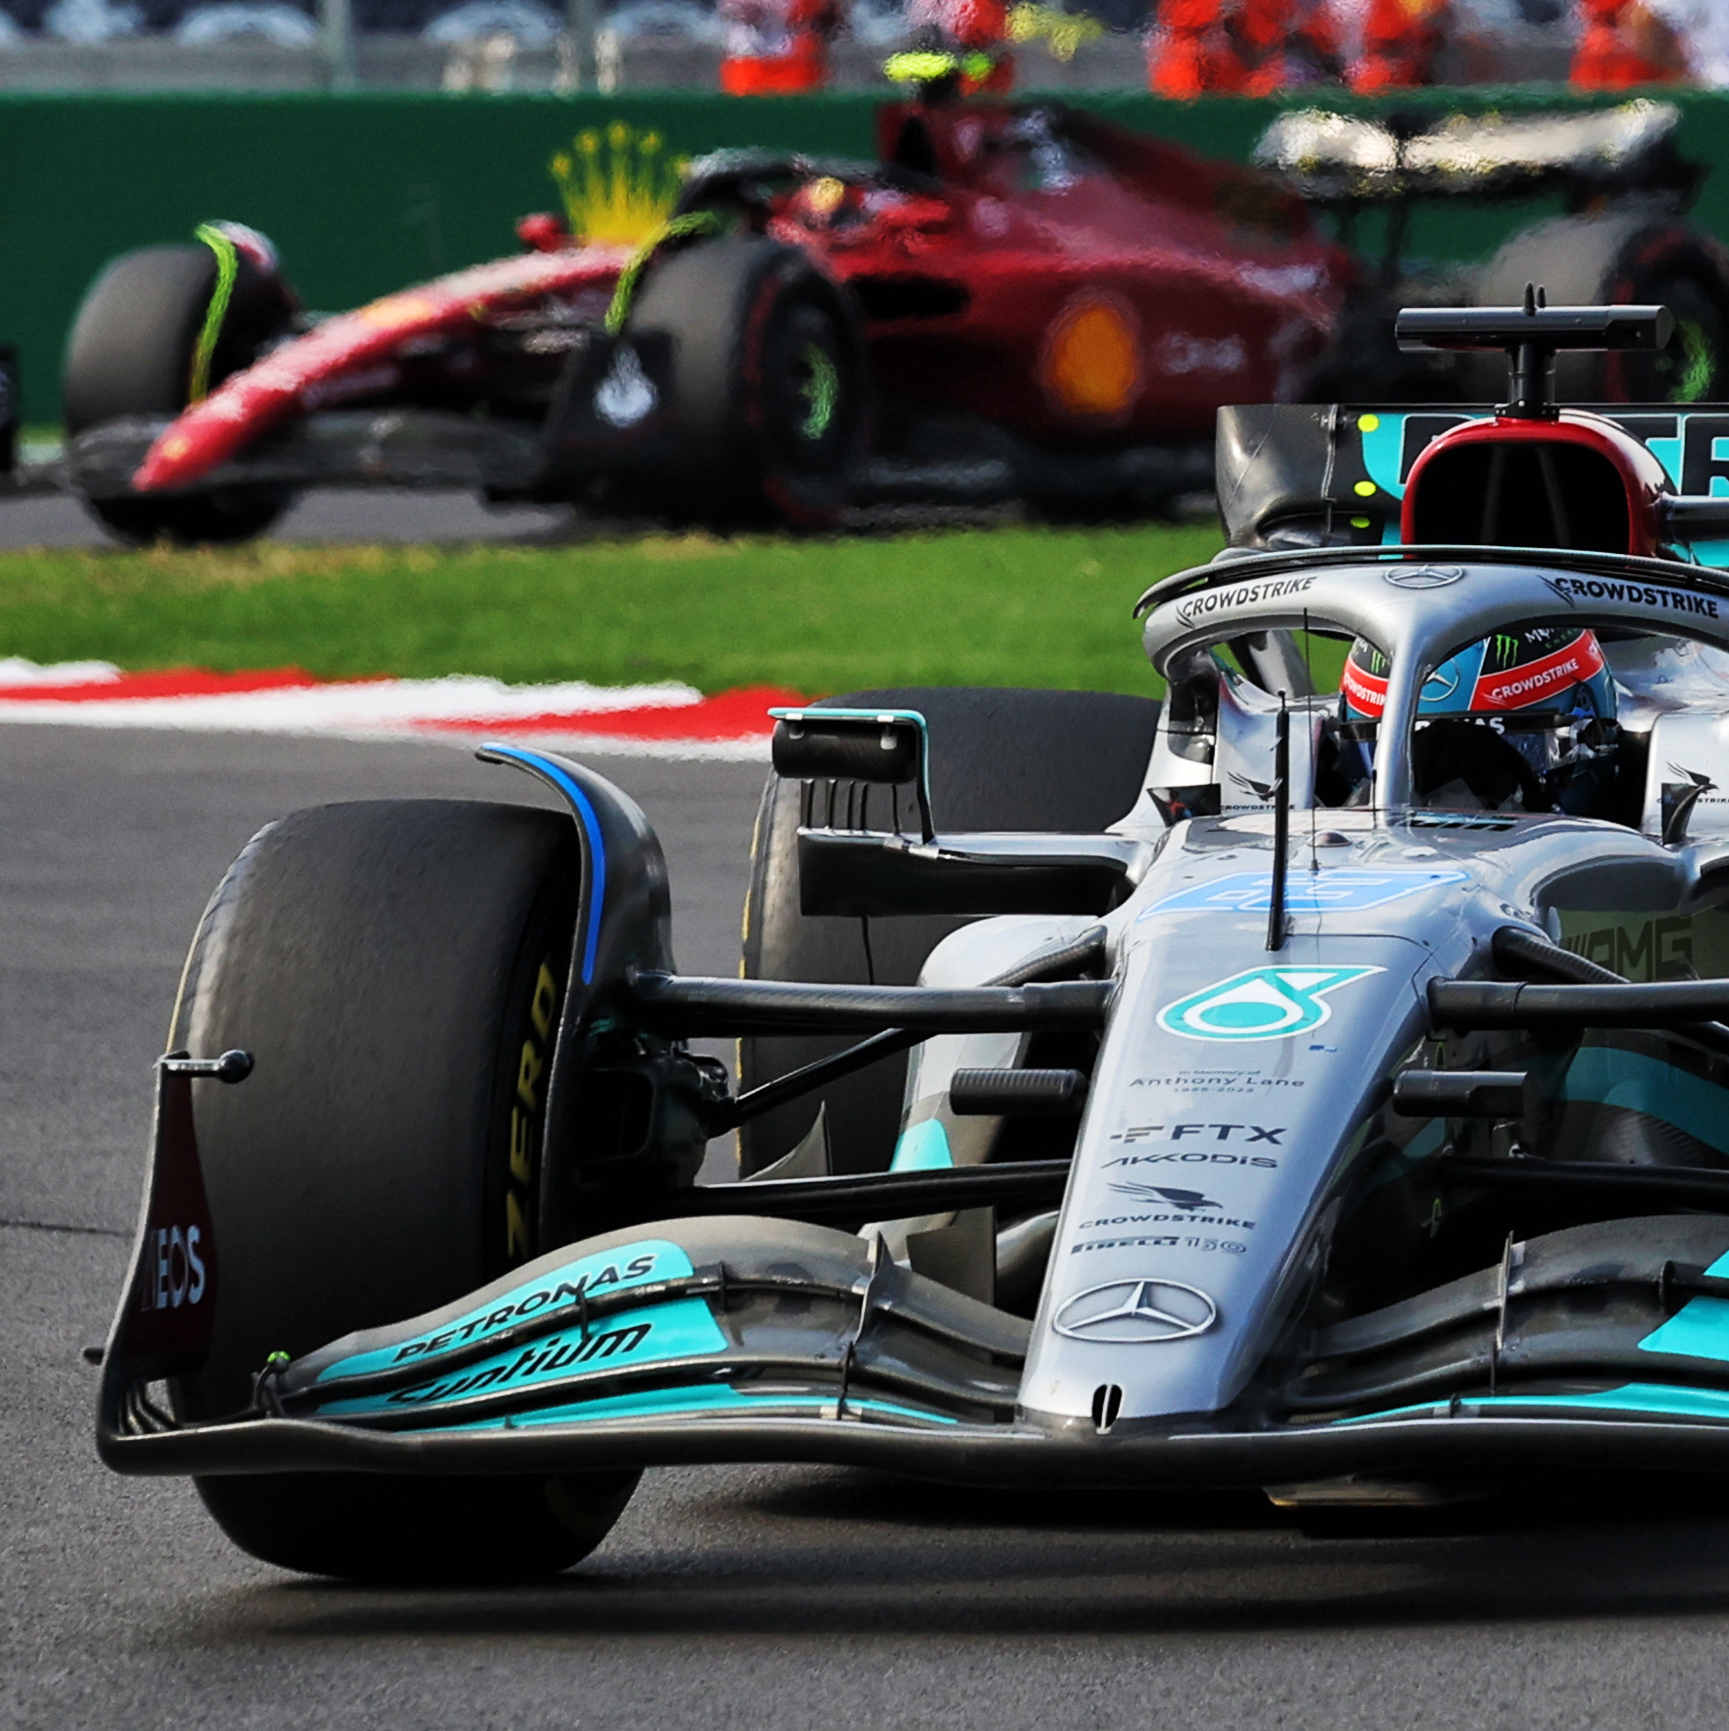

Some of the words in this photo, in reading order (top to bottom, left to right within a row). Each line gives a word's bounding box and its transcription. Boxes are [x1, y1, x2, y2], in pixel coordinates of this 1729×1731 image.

[1182, 576, 1317, 617] CROWDSTRIKE
[1554, 576, 1719, 619] CROWDSTRIKE
[1492, 658, 1579, 700] CROWDSTRIKE
[1129, 1076, 1237, 1087] Anthony
[1246, 1076, 1305, 1087] Lane
[1171, 1124, 1288, 1146] FTX
[1079, 1214, 1257, 1230] CROWDSTRIKE
[393, 1254, 655, 1364] PETRONAS
